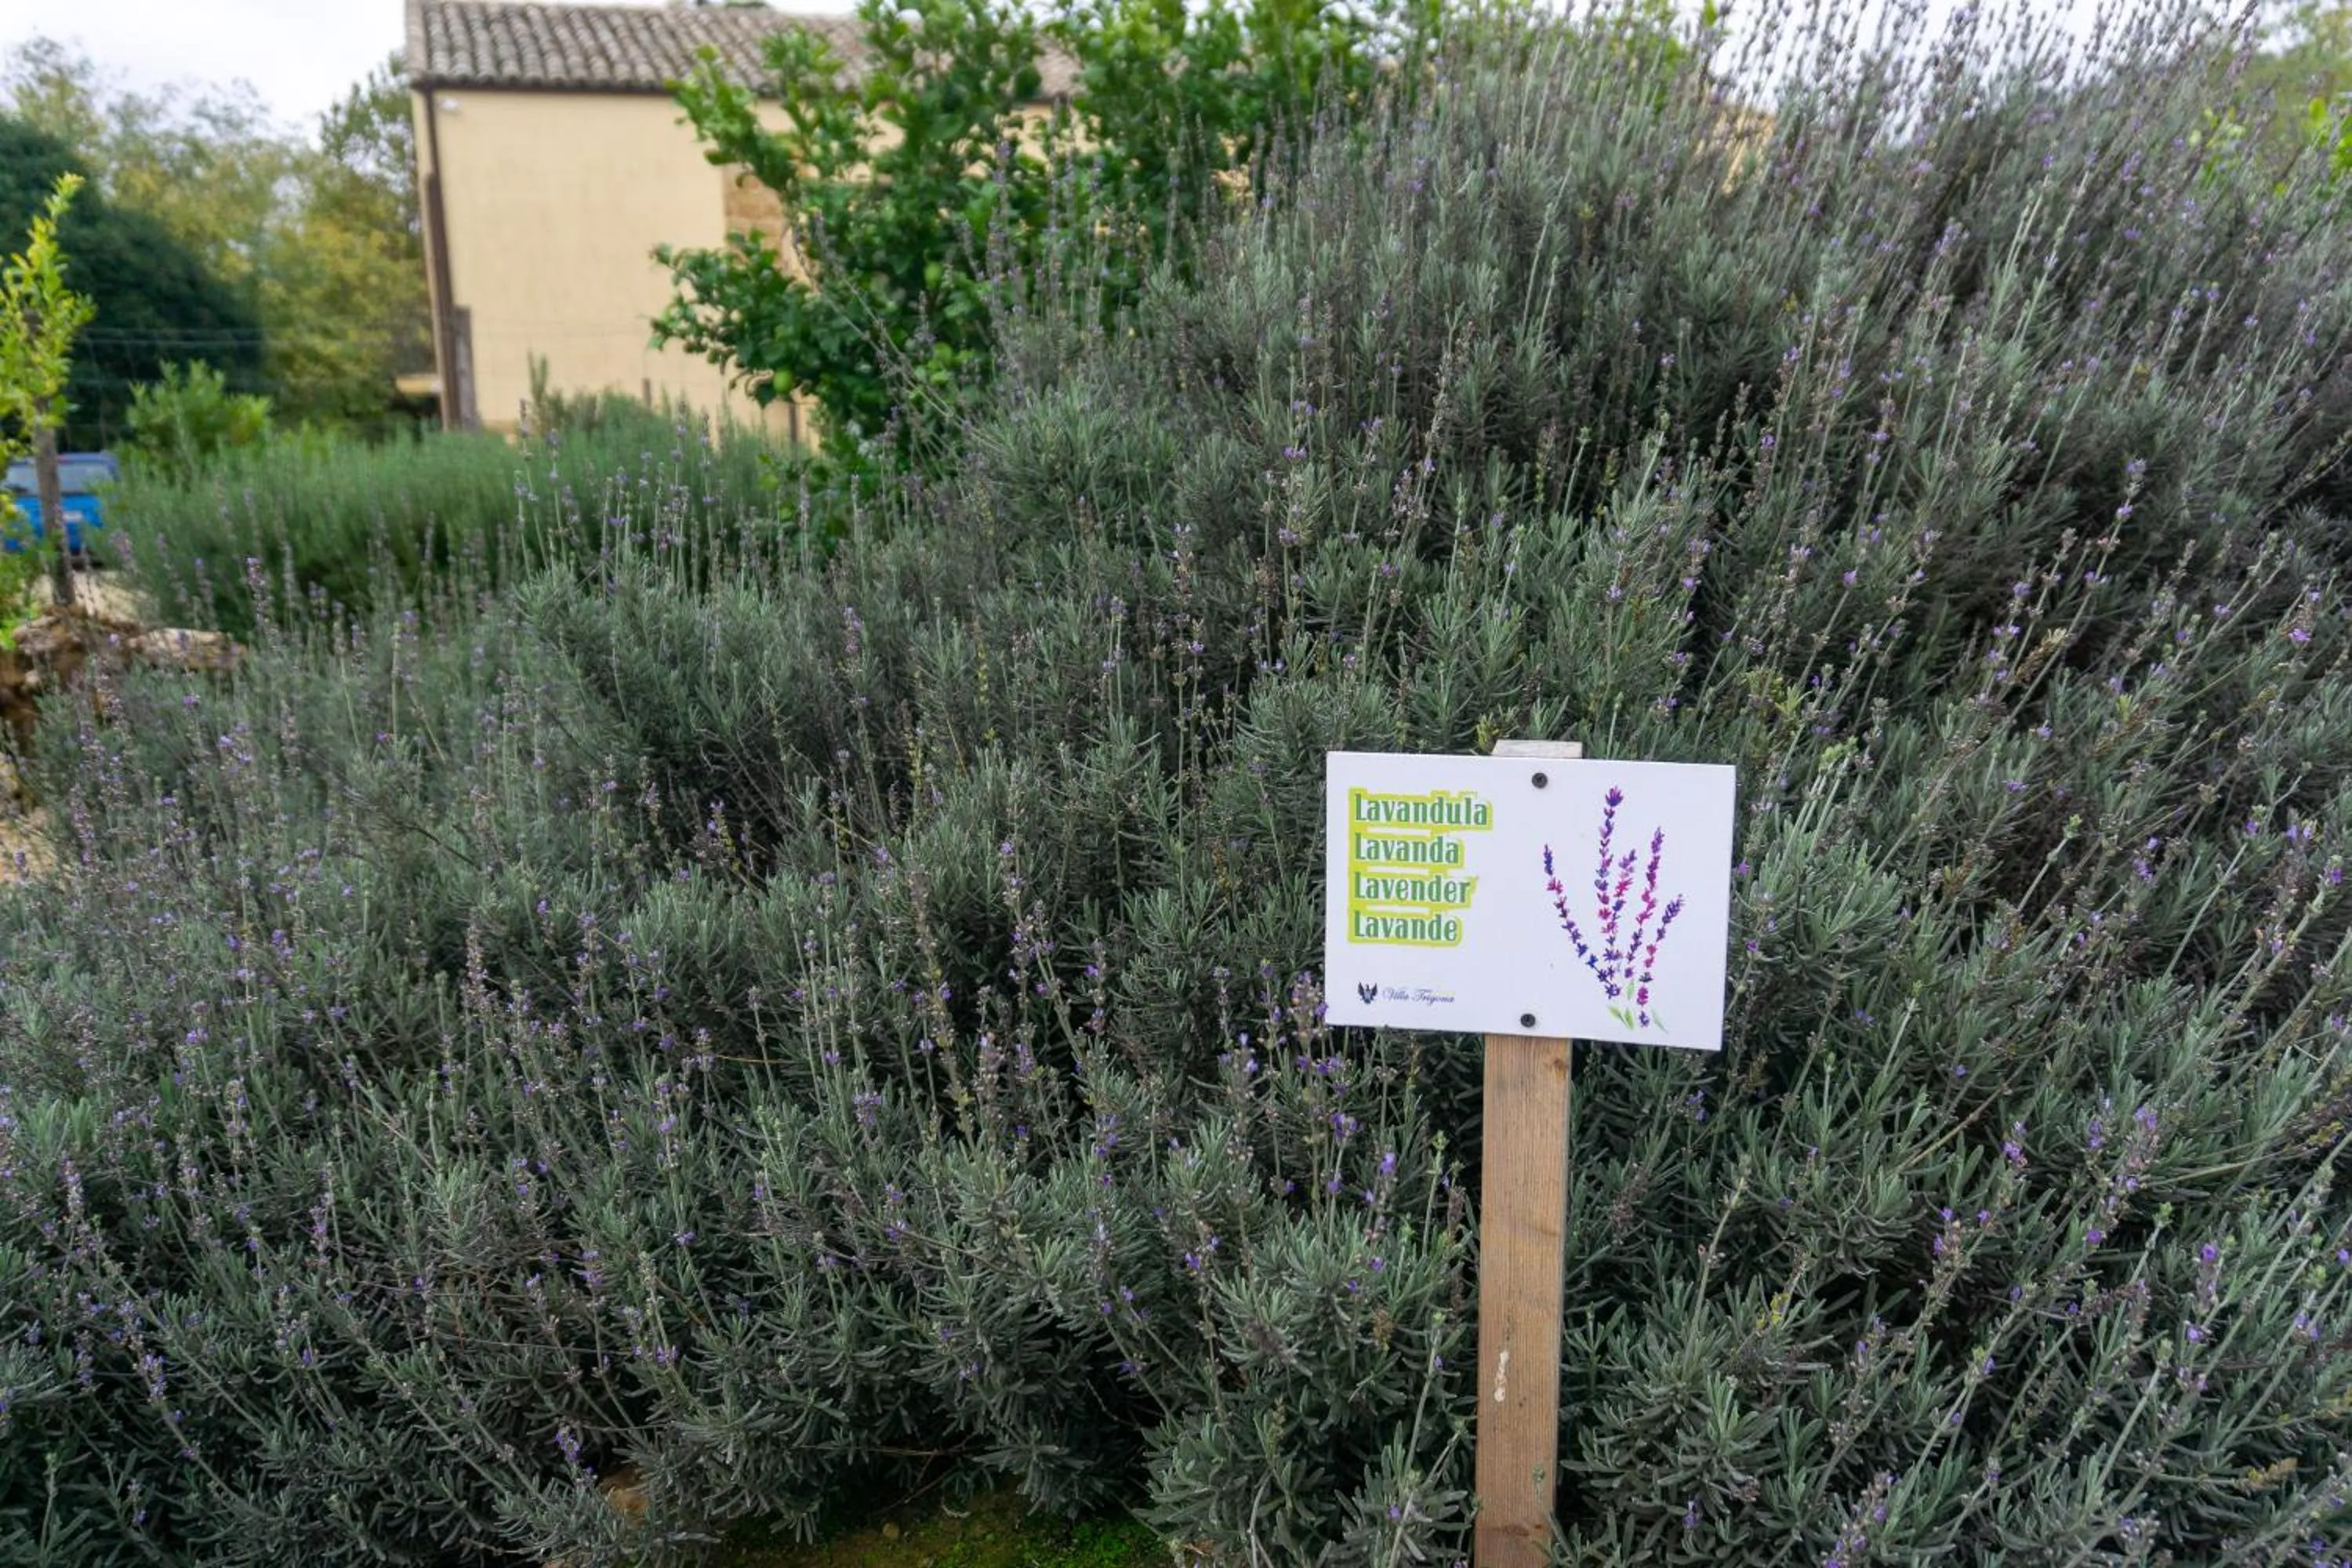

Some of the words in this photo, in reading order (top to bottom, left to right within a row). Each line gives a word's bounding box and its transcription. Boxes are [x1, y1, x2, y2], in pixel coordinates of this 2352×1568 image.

[1355, 793, 1487, 825] Lavandula
[1355, 832, 1459, 863] Lavanda
[1354, 871, 1471, 903] Lavender
[1354, 910, 1458, 942] Lavande
